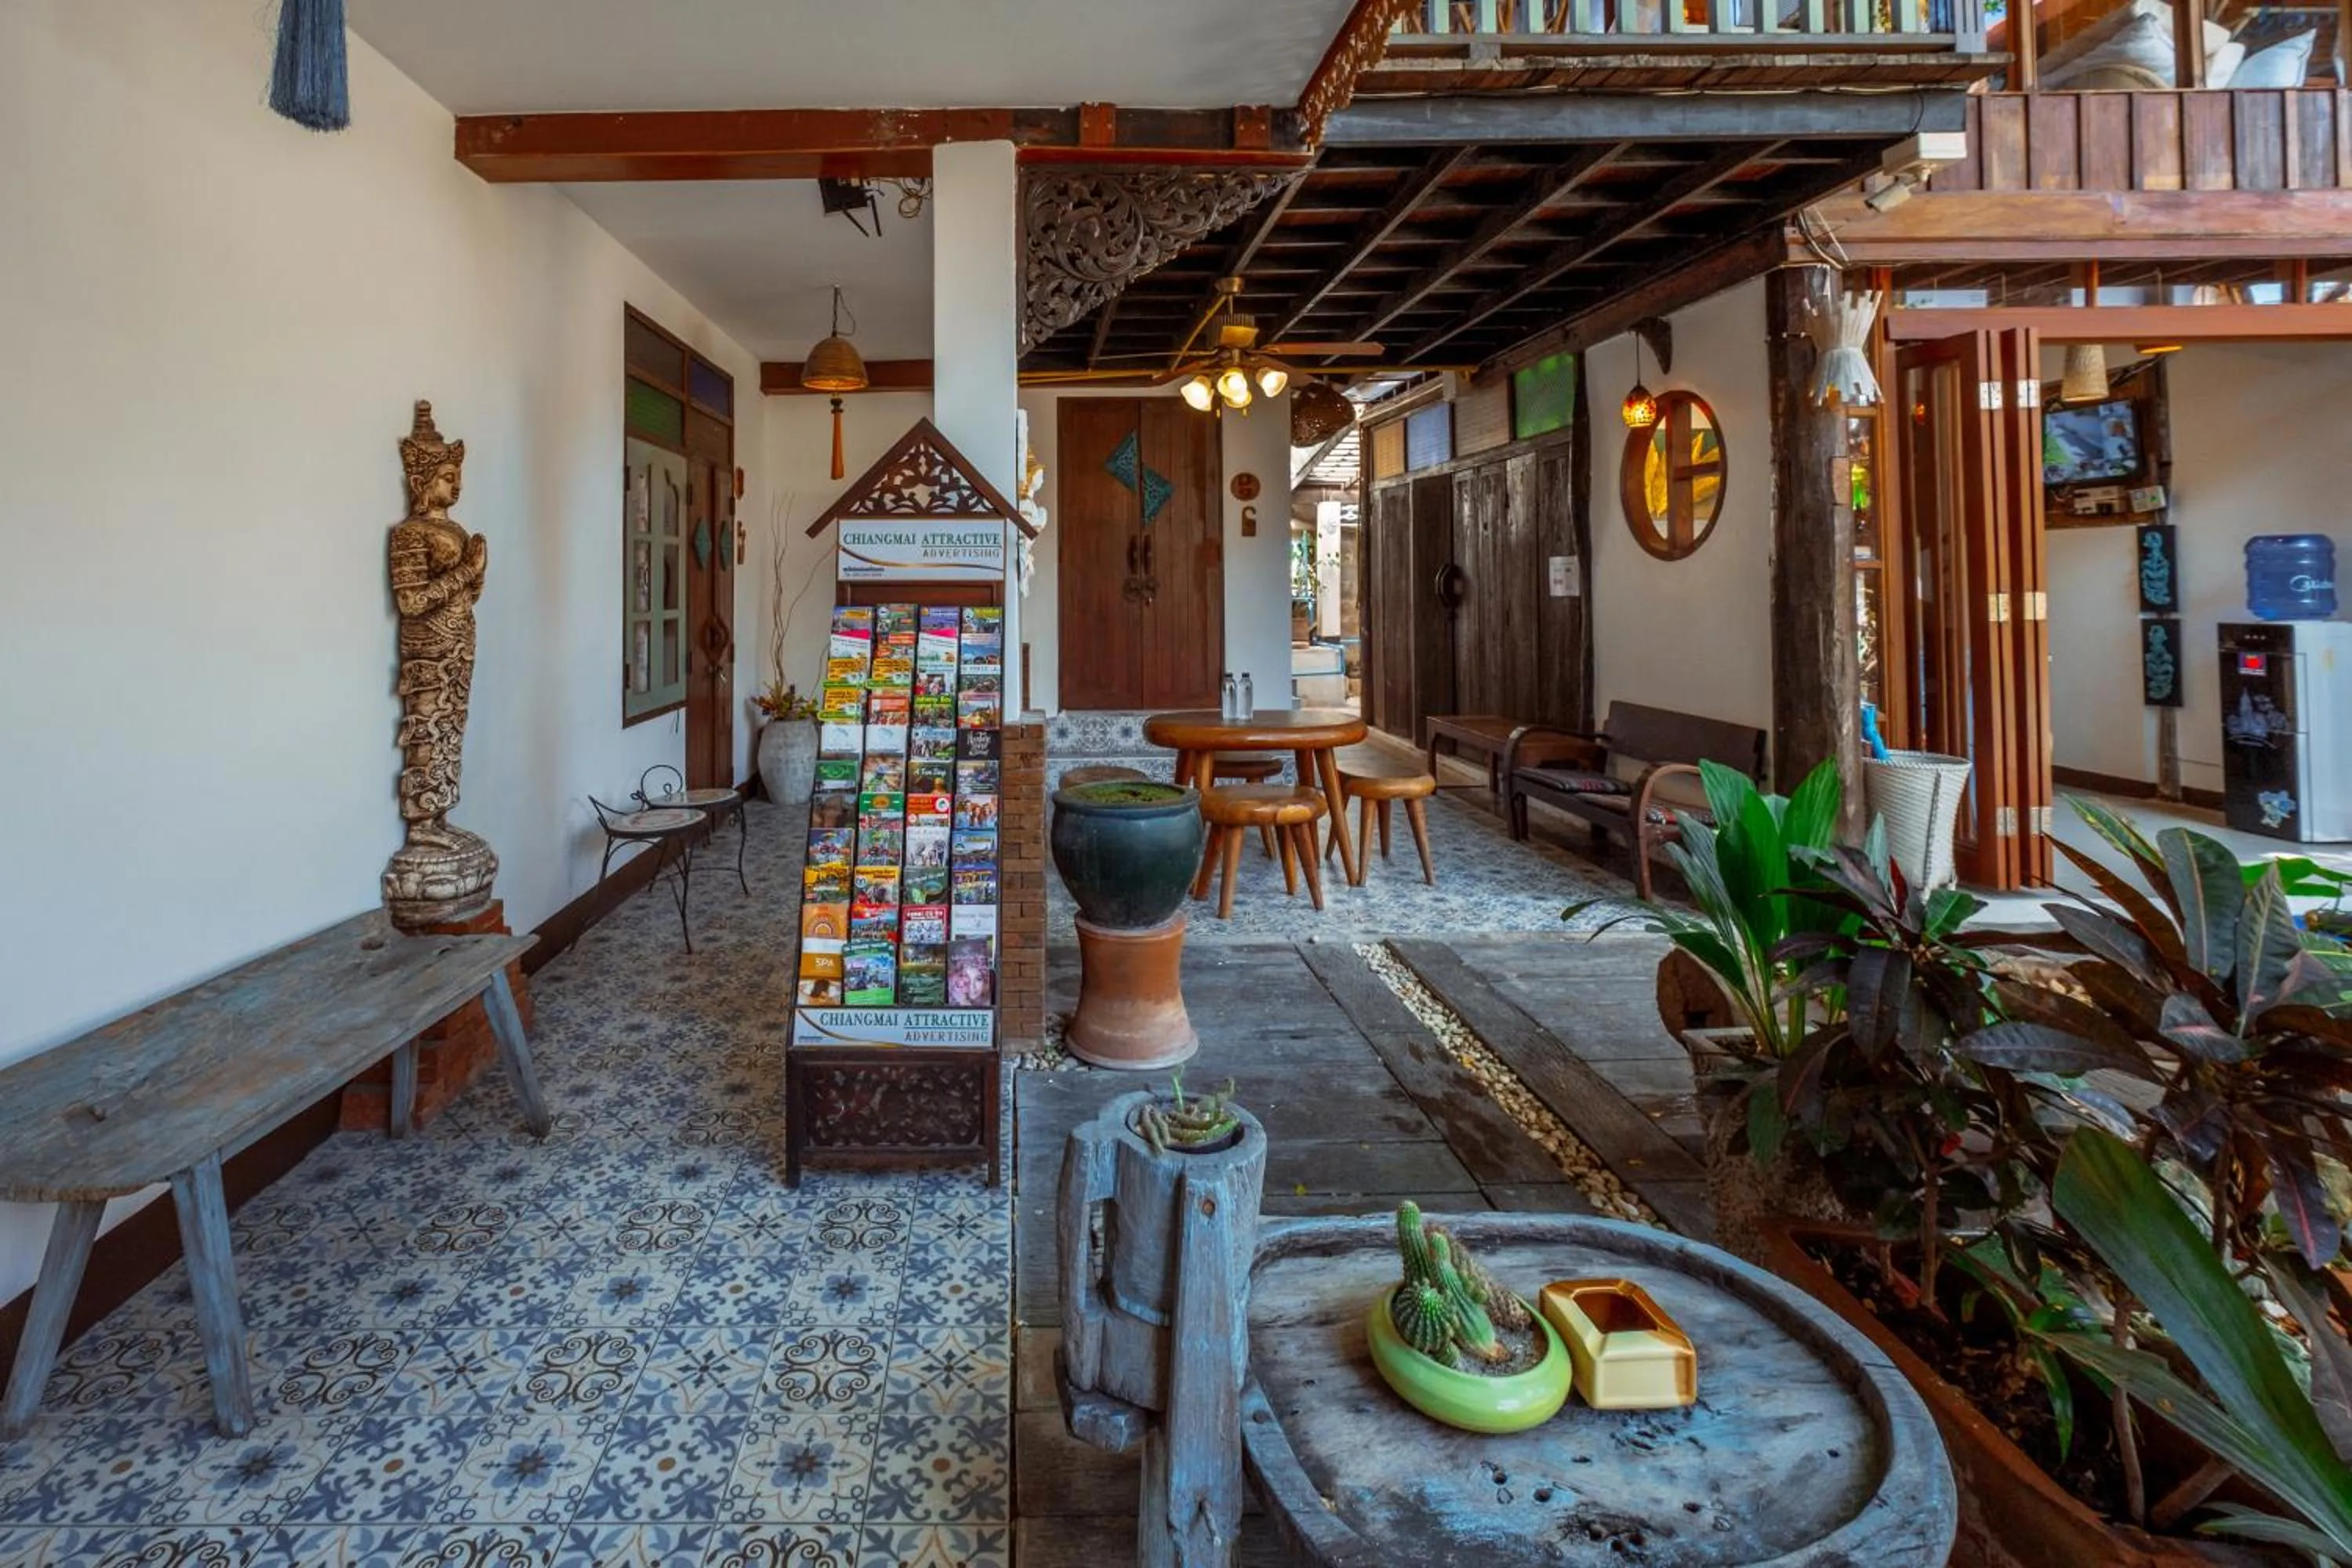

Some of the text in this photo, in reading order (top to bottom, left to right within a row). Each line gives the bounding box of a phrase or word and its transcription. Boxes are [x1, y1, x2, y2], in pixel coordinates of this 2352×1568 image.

[843, 532, 1001, 546] CHIANGMAI ATTRACTIVE
[923, 548, 1000, 559] ADVERTISING
[815, 957, 834, 967] SPA
[820, 1012, 989, 1027] CHIANGMAI ATTRACTIVE
[904, 1030, 989, 1043] ADVERTISING
